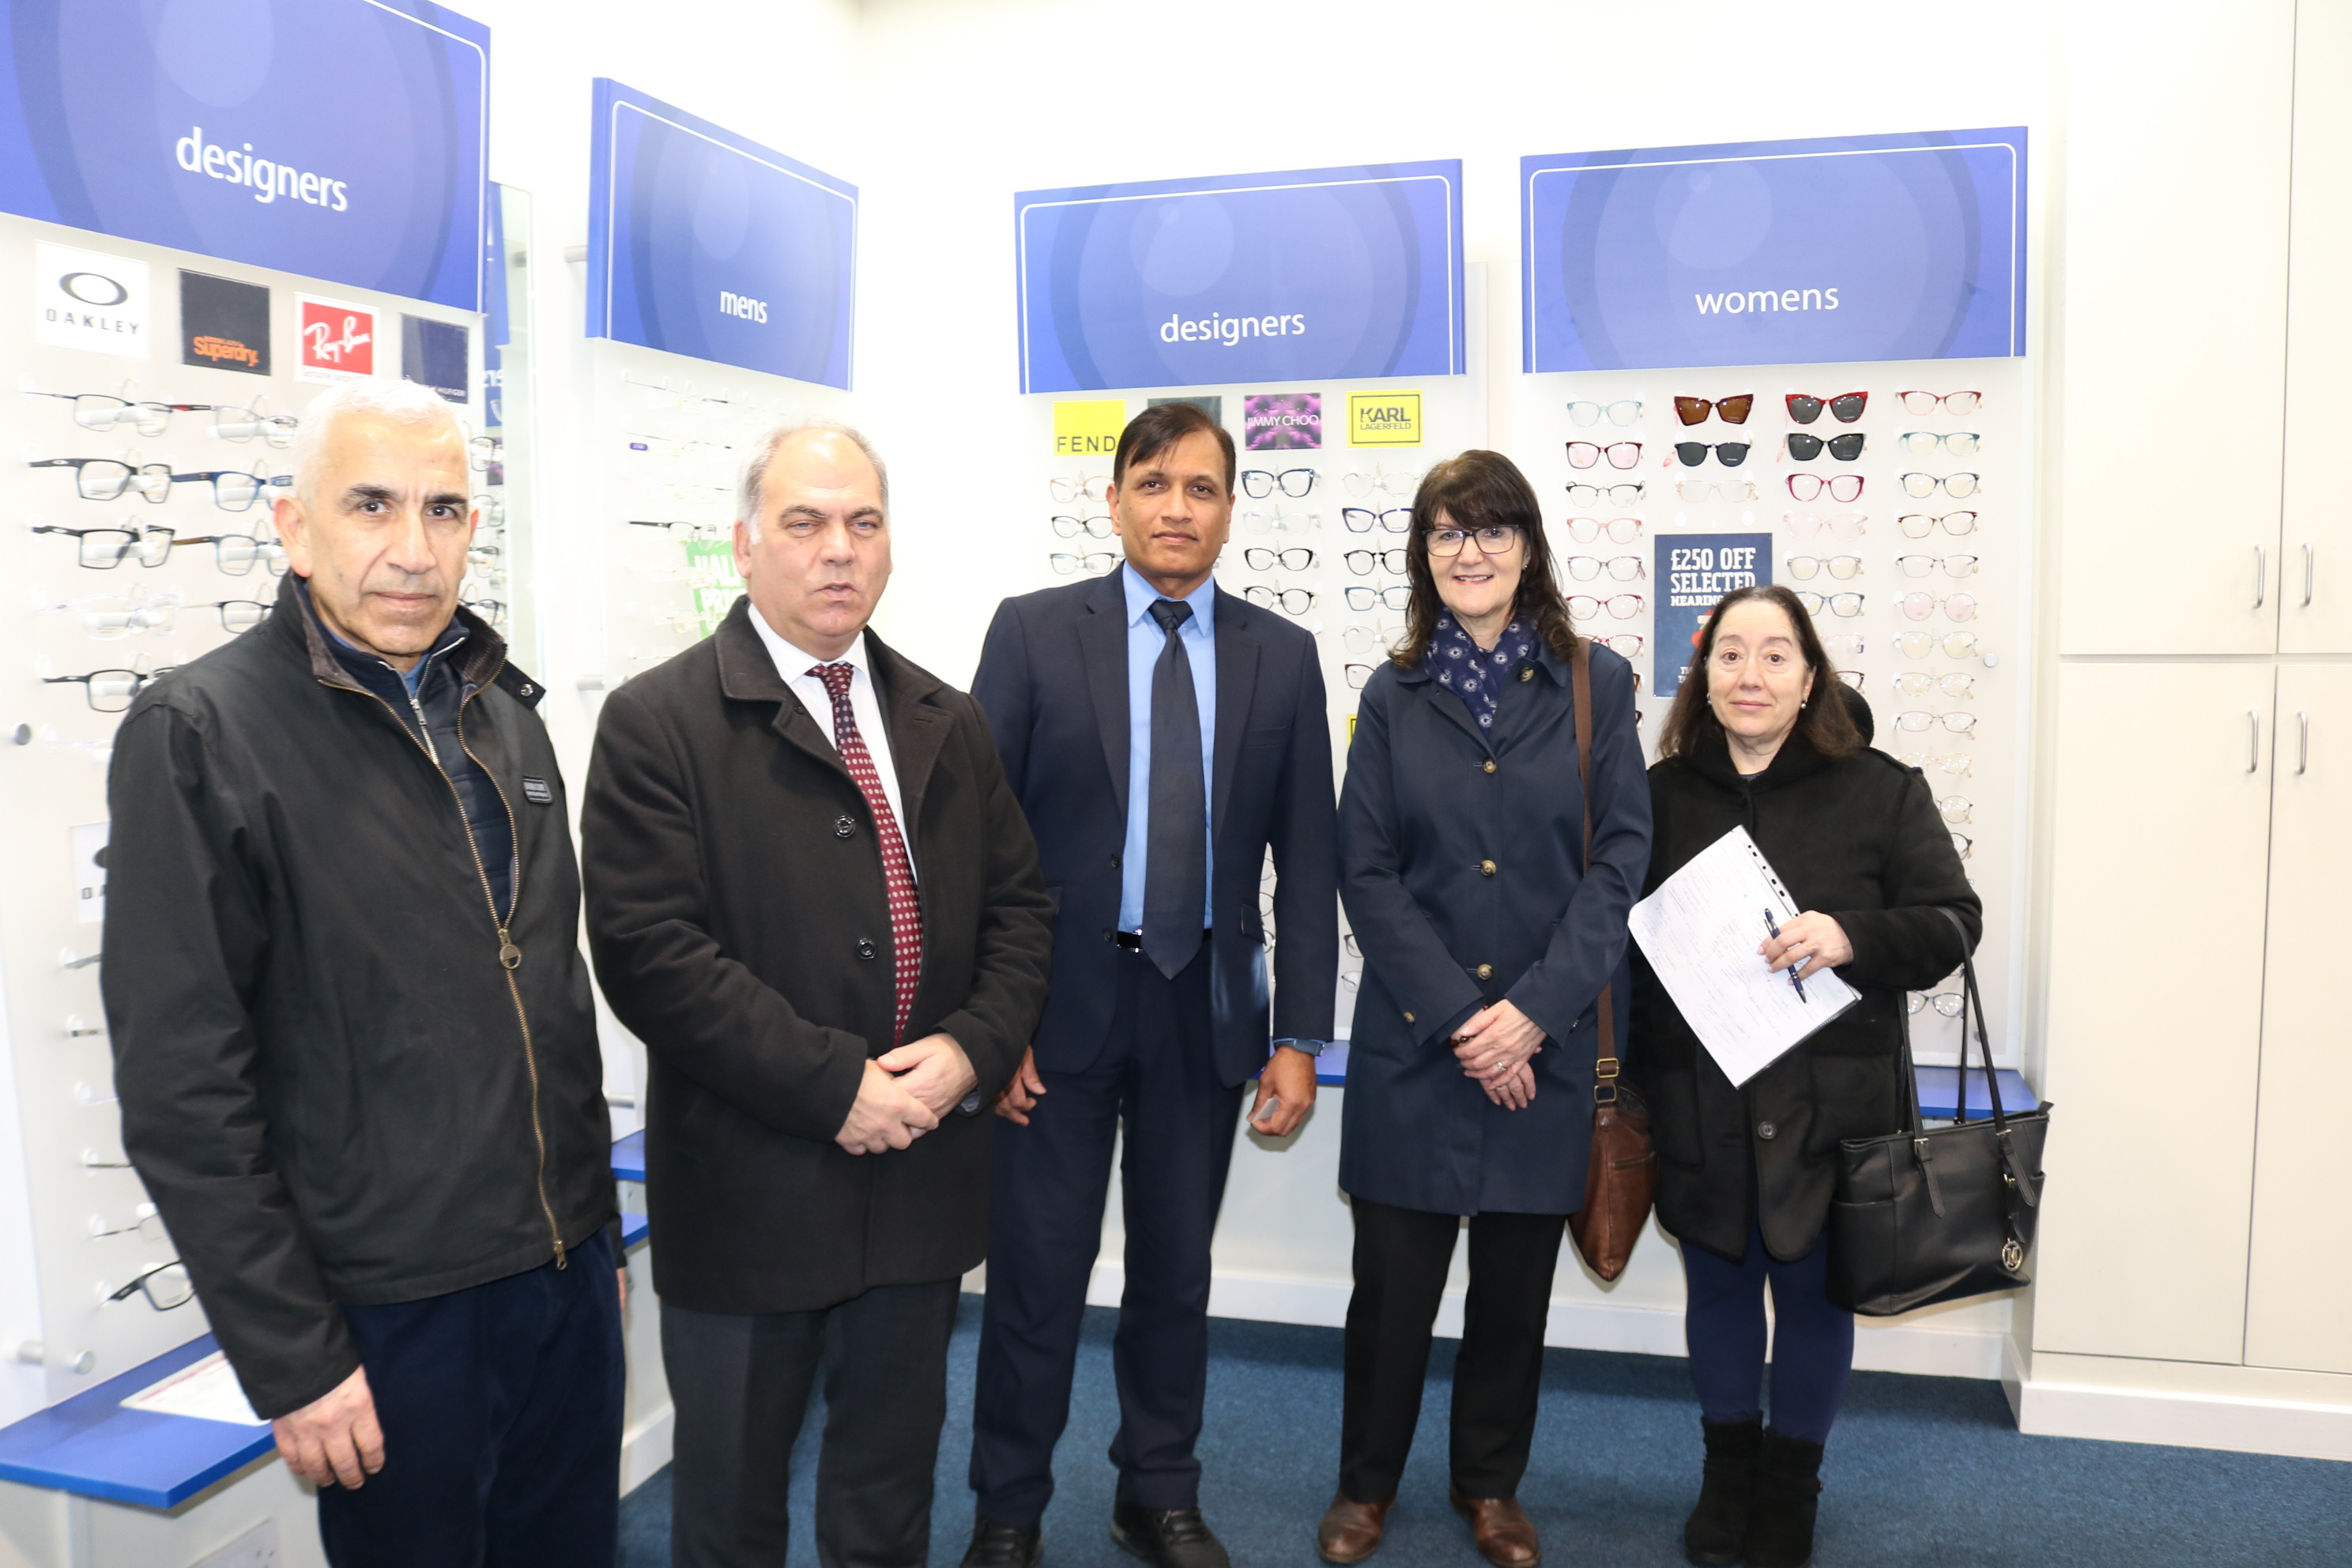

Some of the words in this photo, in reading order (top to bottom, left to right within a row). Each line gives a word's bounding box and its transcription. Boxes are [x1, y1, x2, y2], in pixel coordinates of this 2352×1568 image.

[176, 126, 348, 212] designers
[720, 290, 767, 324] mens
[1694, 287, 1839, 315] womens
[46, 308, 139, 335] OAKLEY
[1160, 312, 1305, 346] designers
[303, 315, 371, 364] Ray-Ban
[1246, 415, 1280, 430] JIMMY
[1282, 414, 1319, 427] CHOO
[1360, 406, 1411, 423] KARL
[1360, 422, 1412, 431] LAGERFELD
[1057, 435, 1117, 452] FEND
[694, 553, 742, 587] HAL
[1670, 548, 1713, 571] £250
[1720, 548, 1756, 570] OFF
[1670, 571, 1756, 594] SELECTED
